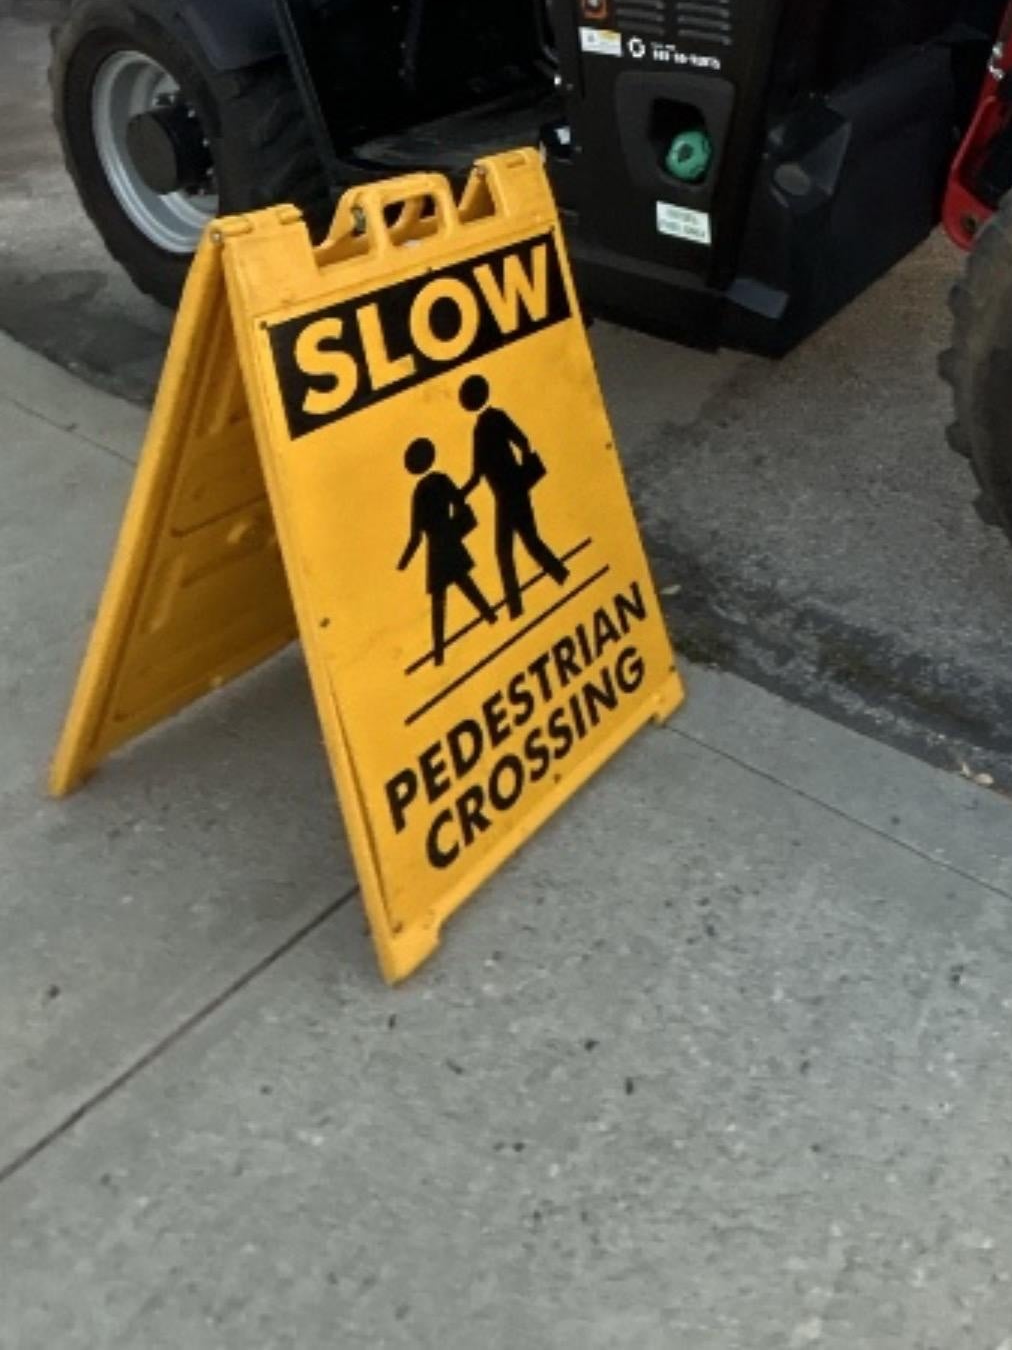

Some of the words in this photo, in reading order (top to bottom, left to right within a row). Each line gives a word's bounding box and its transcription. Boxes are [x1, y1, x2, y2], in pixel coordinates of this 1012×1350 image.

[294, 243, 550, 415] SLOW
[384, 581, 648, 833] PEDESTRIAN
[424, 645, 647, 869] CROSSING
